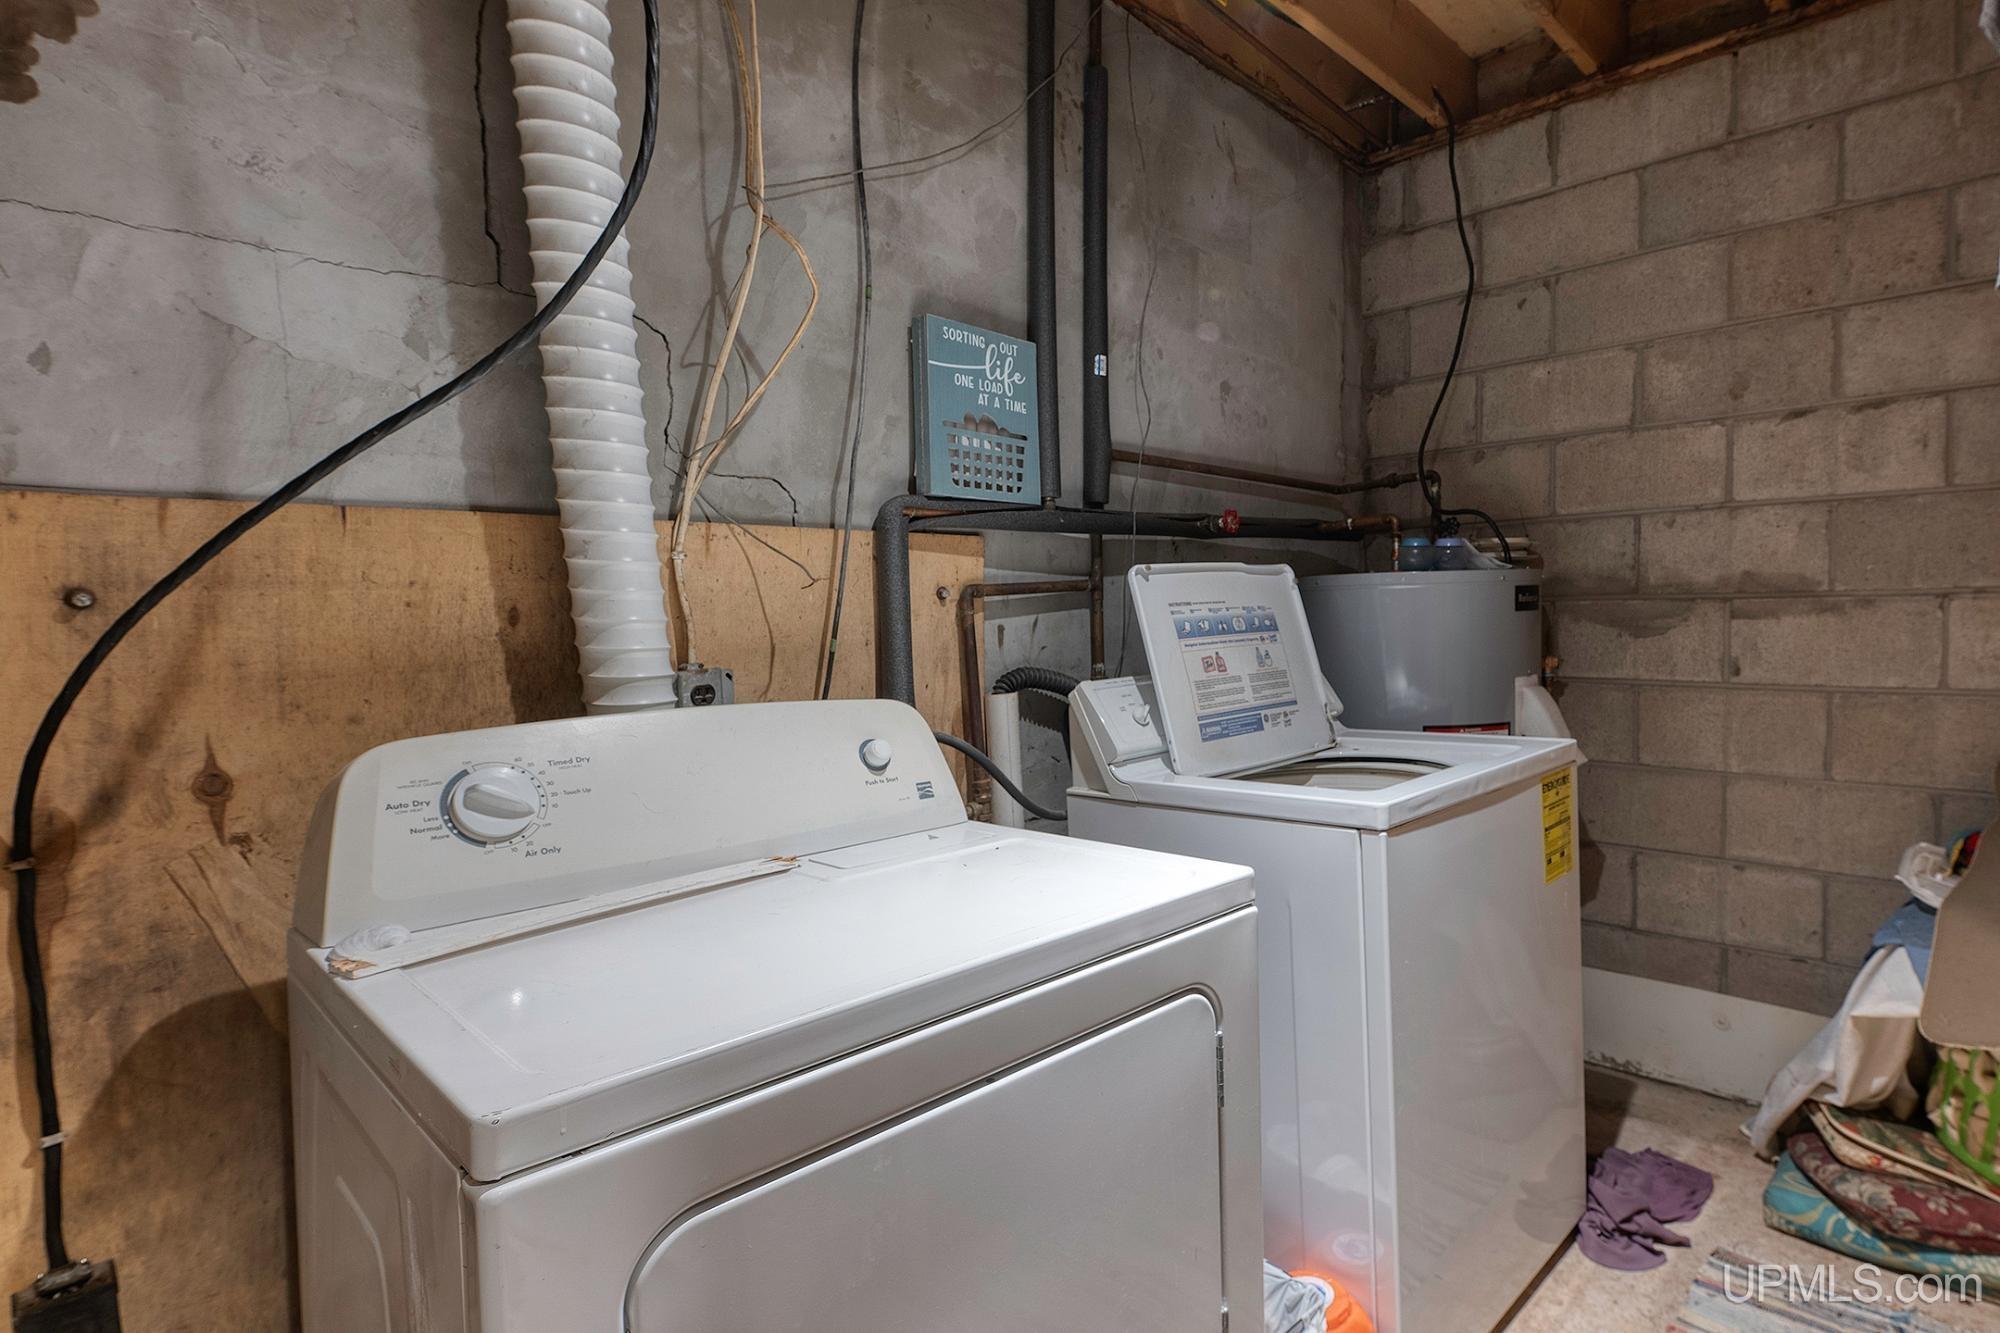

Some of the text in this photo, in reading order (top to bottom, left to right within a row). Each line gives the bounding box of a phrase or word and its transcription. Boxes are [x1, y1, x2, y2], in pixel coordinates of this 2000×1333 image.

[943, 326, 1018, 356] SORTING OUT
[985, 344, 1026, 397] life
[954, 373, 1004, 395] ONE LOAD
[978, 393, 1027, 414] AT A TIME
[547, 757, 573, 766] Timed
[385, 803, 409, 811] Auto
[410, 824, 443, 834] Normal
[525, 845, 562, 857] Air Only
